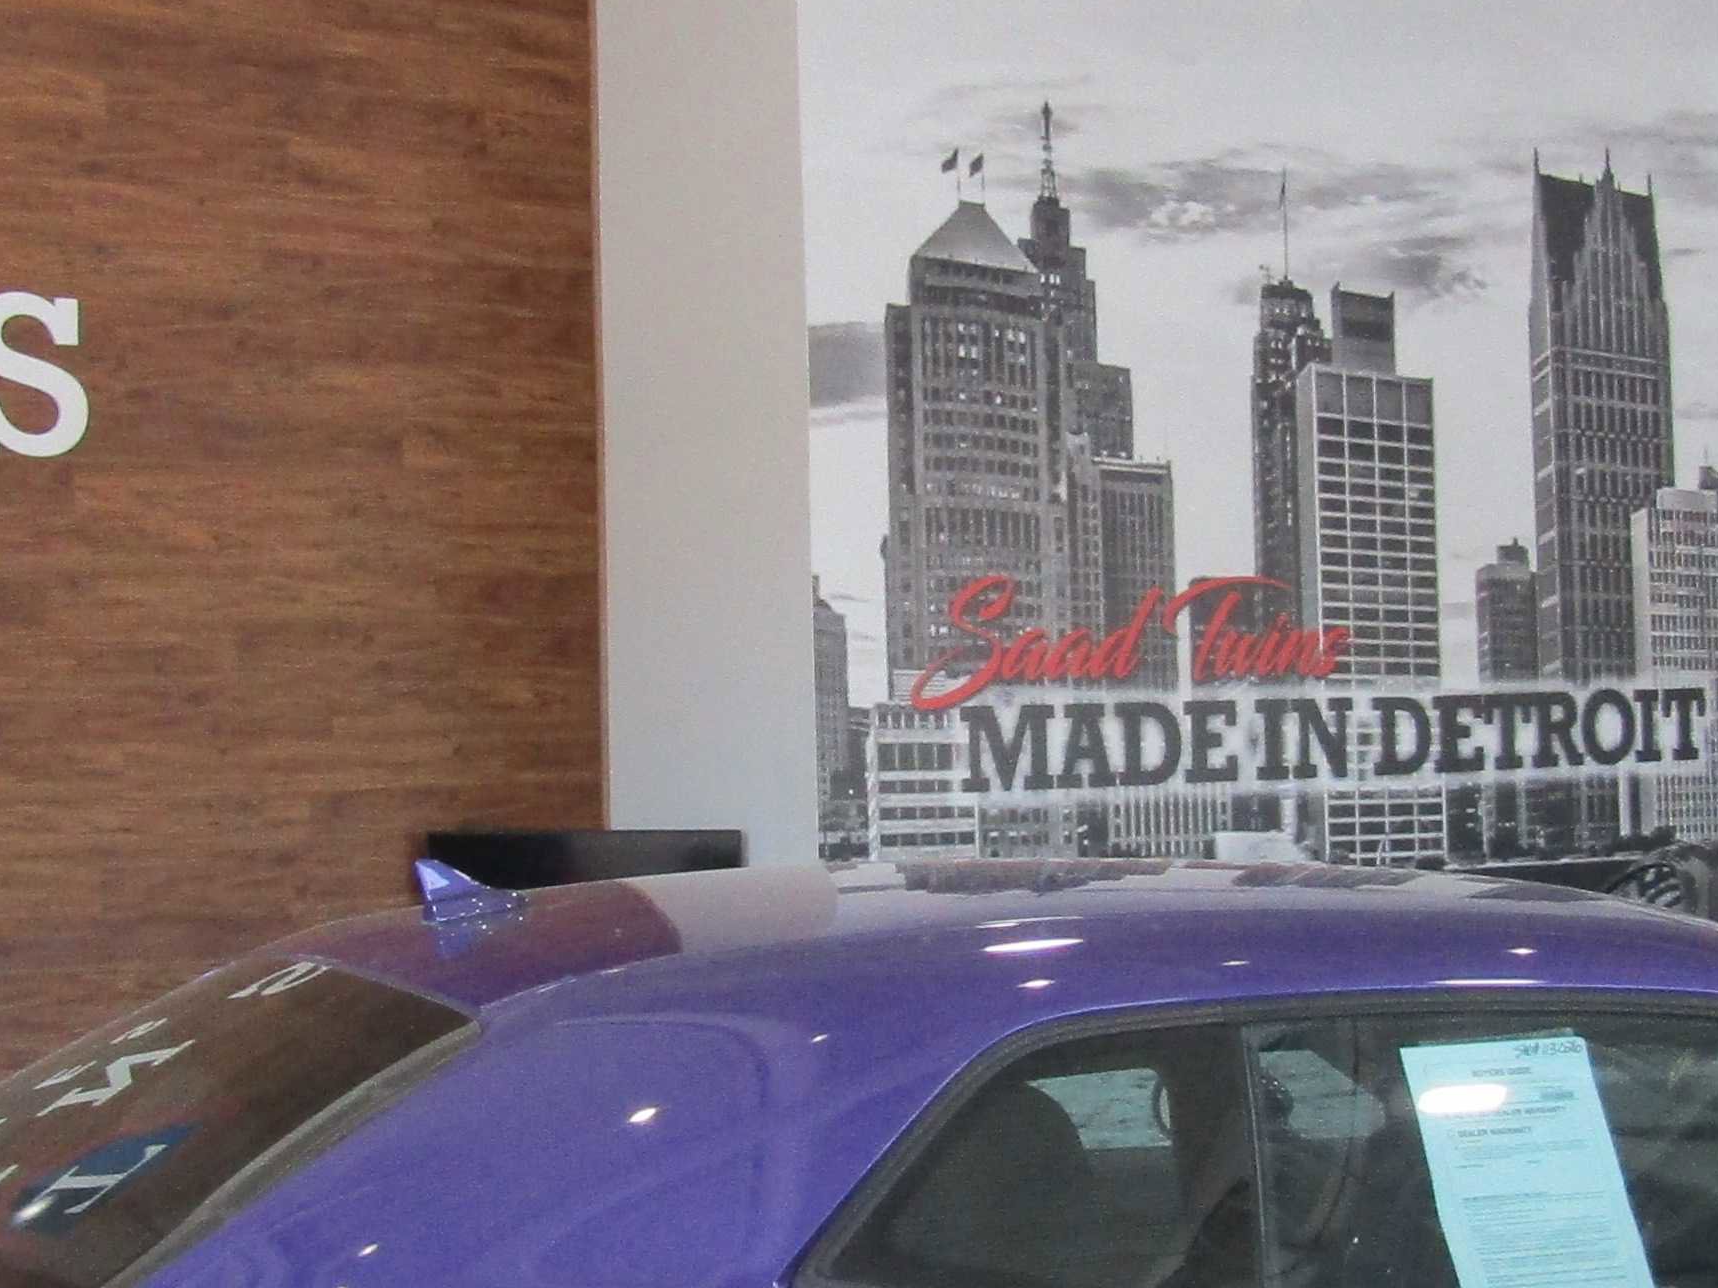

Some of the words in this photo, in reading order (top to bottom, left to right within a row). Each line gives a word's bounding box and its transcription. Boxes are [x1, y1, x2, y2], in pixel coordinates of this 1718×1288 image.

[911, 575, 1163, 710] Saad
[1163, 575, 1352, 682] Twins
[961, 699, 1238, 793] MADE
[1256, 696, 1354, 779] IN
[1373, 688, 1706, 778] DETROIT
